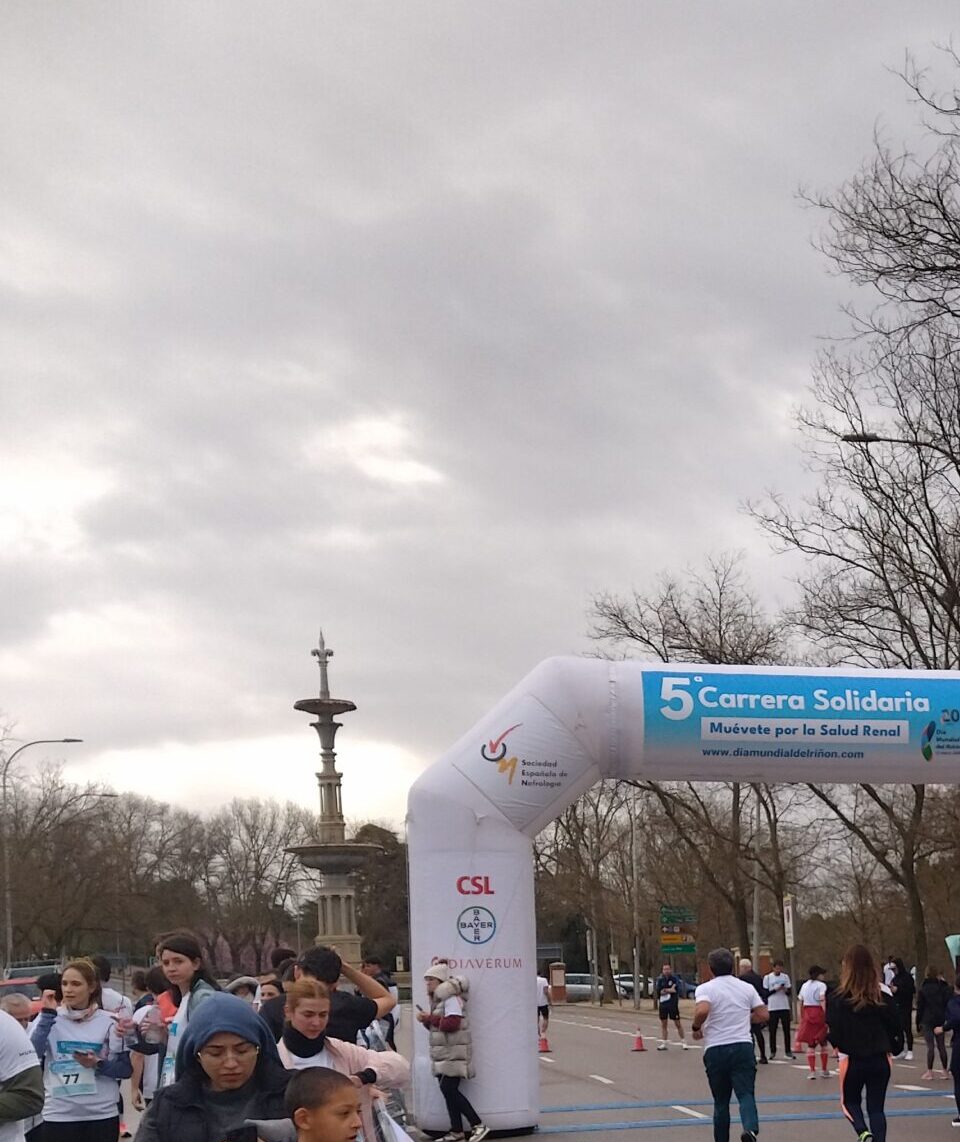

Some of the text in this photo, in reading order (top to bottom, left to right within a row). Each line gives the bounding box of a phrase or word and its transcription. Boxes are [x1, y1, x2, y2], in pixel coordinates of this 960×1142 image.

[698, 686, 805, 710] Carrera
[813, 689, 930, 712] Solidaria
[710, 722, 901, 738] Muévete por la Salud Renal
[702, 747, 865, 760] www.diamundialdelriñon.com
[521, 759, 558, 768] Sociedad
[456, 876, 495, 895] CSL
[460, 921, 494, 929] BAYER
[448, 958, 523, 970] DIAVERUM
[62, 1074, 79, 1085] 77
